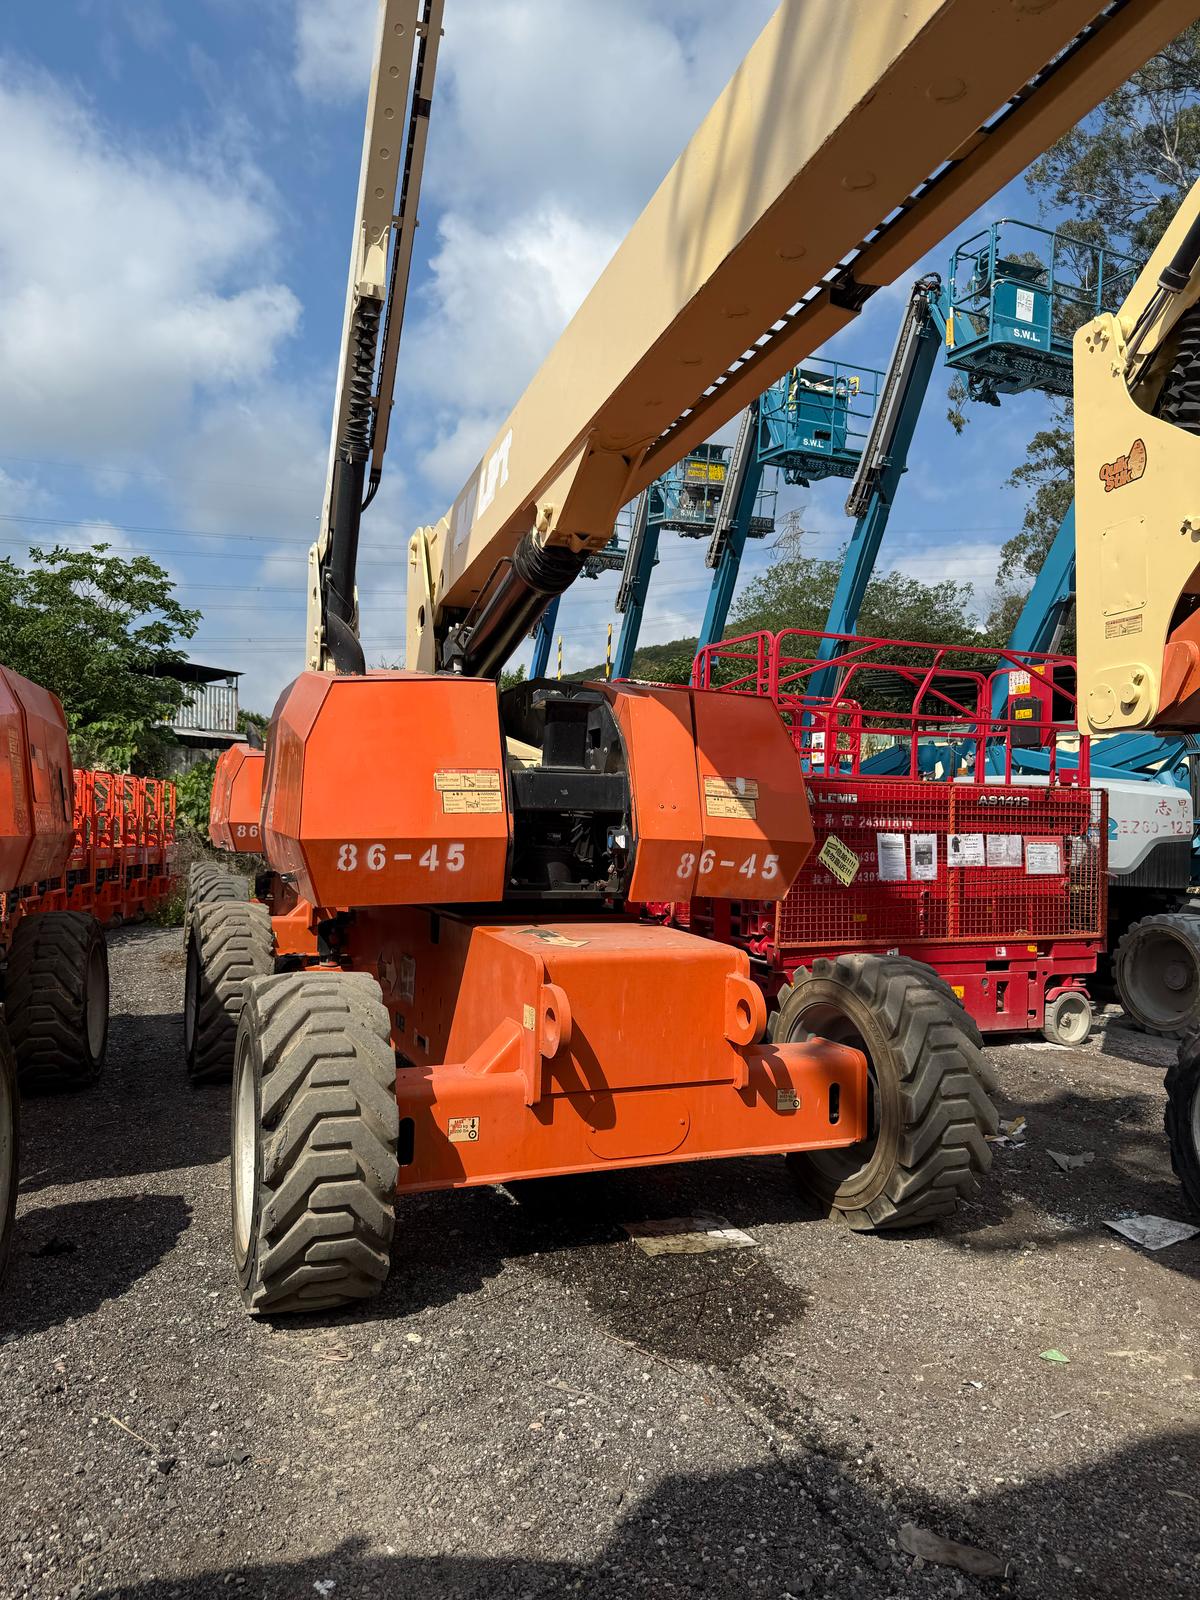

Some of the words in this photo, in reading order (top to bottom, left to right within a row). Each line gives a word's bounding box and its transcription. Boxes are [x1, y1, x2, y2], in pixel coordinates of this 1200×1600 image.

[1013, 328, 1041, 343] S.W.L.
[978, 794, 1030, 807] AS1413
[336, 843, 465, 873] 86-45
[676, 849, 780, 880] 86-45
